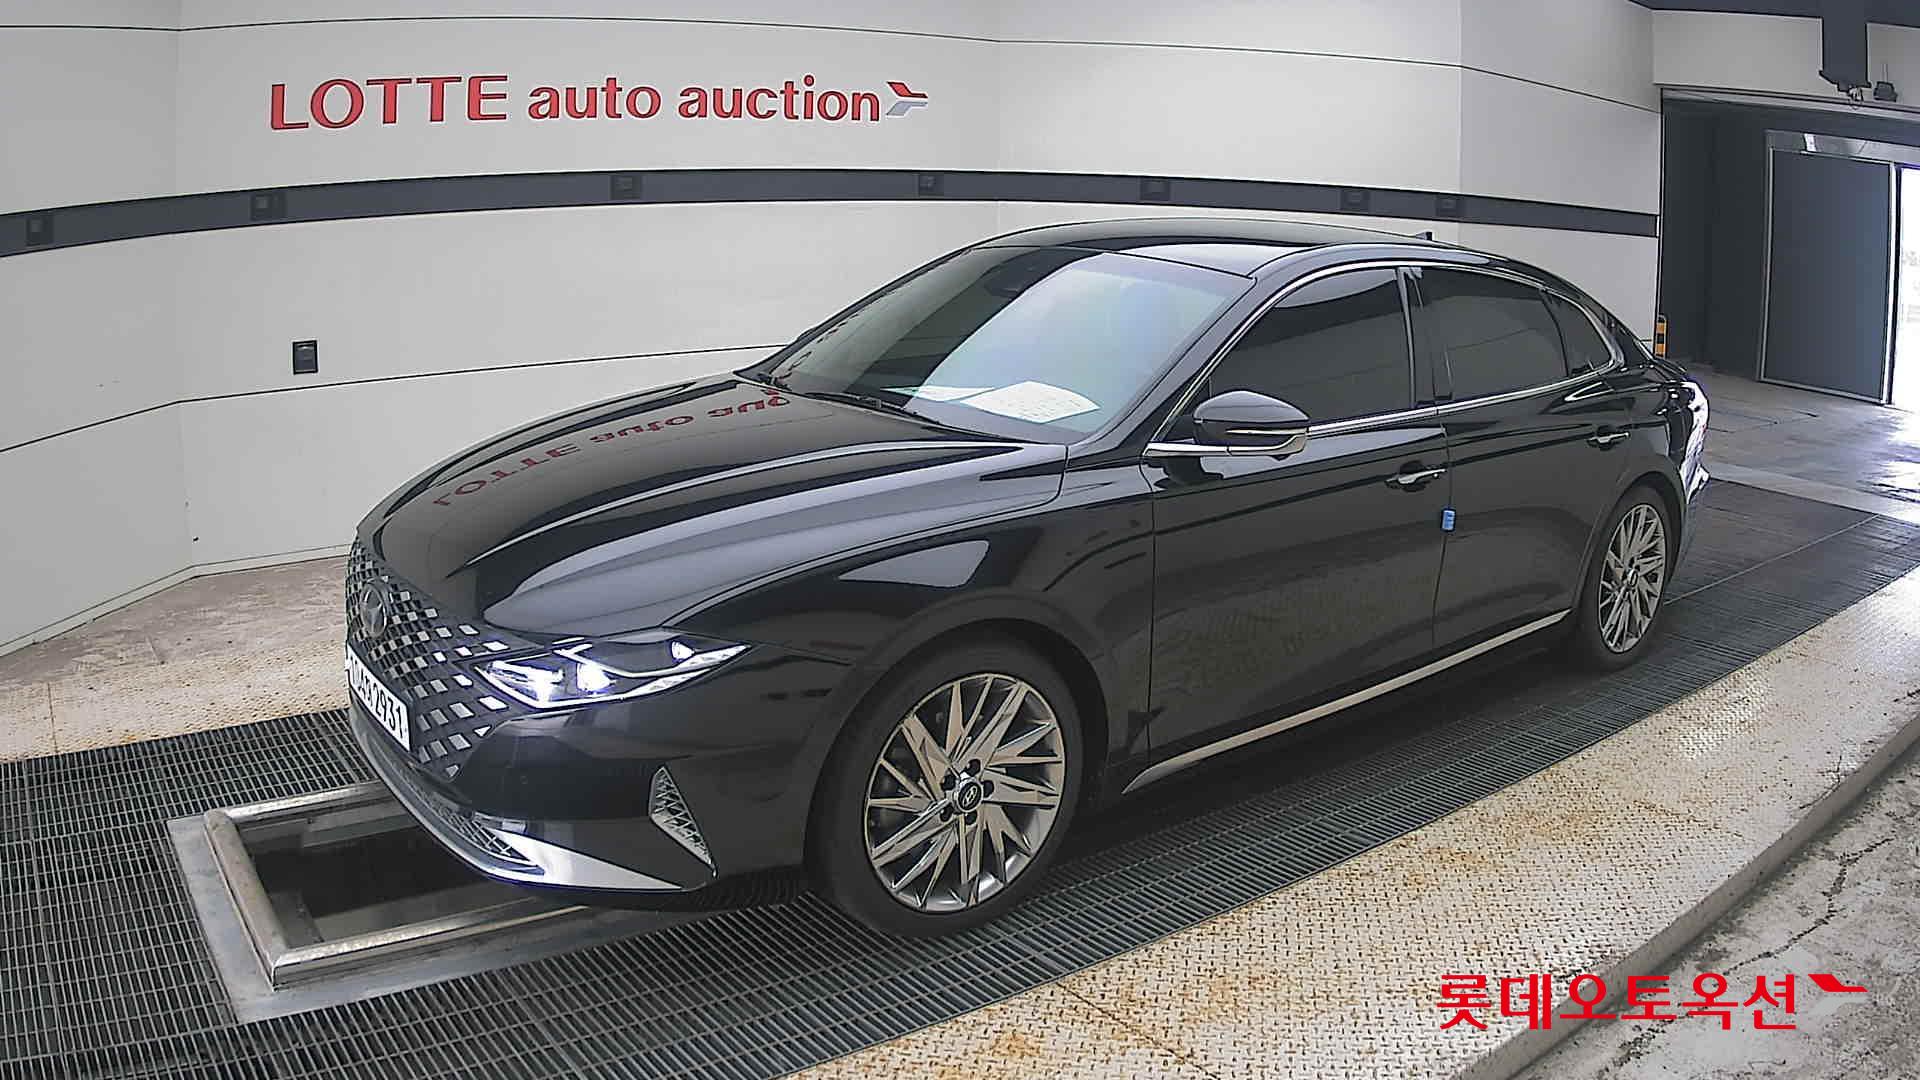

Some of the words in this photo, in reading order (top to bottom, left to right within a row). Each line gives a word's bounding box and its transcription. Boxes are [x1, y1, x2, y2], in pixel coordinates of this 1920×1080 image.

[270, 75, 507, 131] LOTTE
[527, 77, 662, 120] auto
[677, 75, 881, 122] auction
